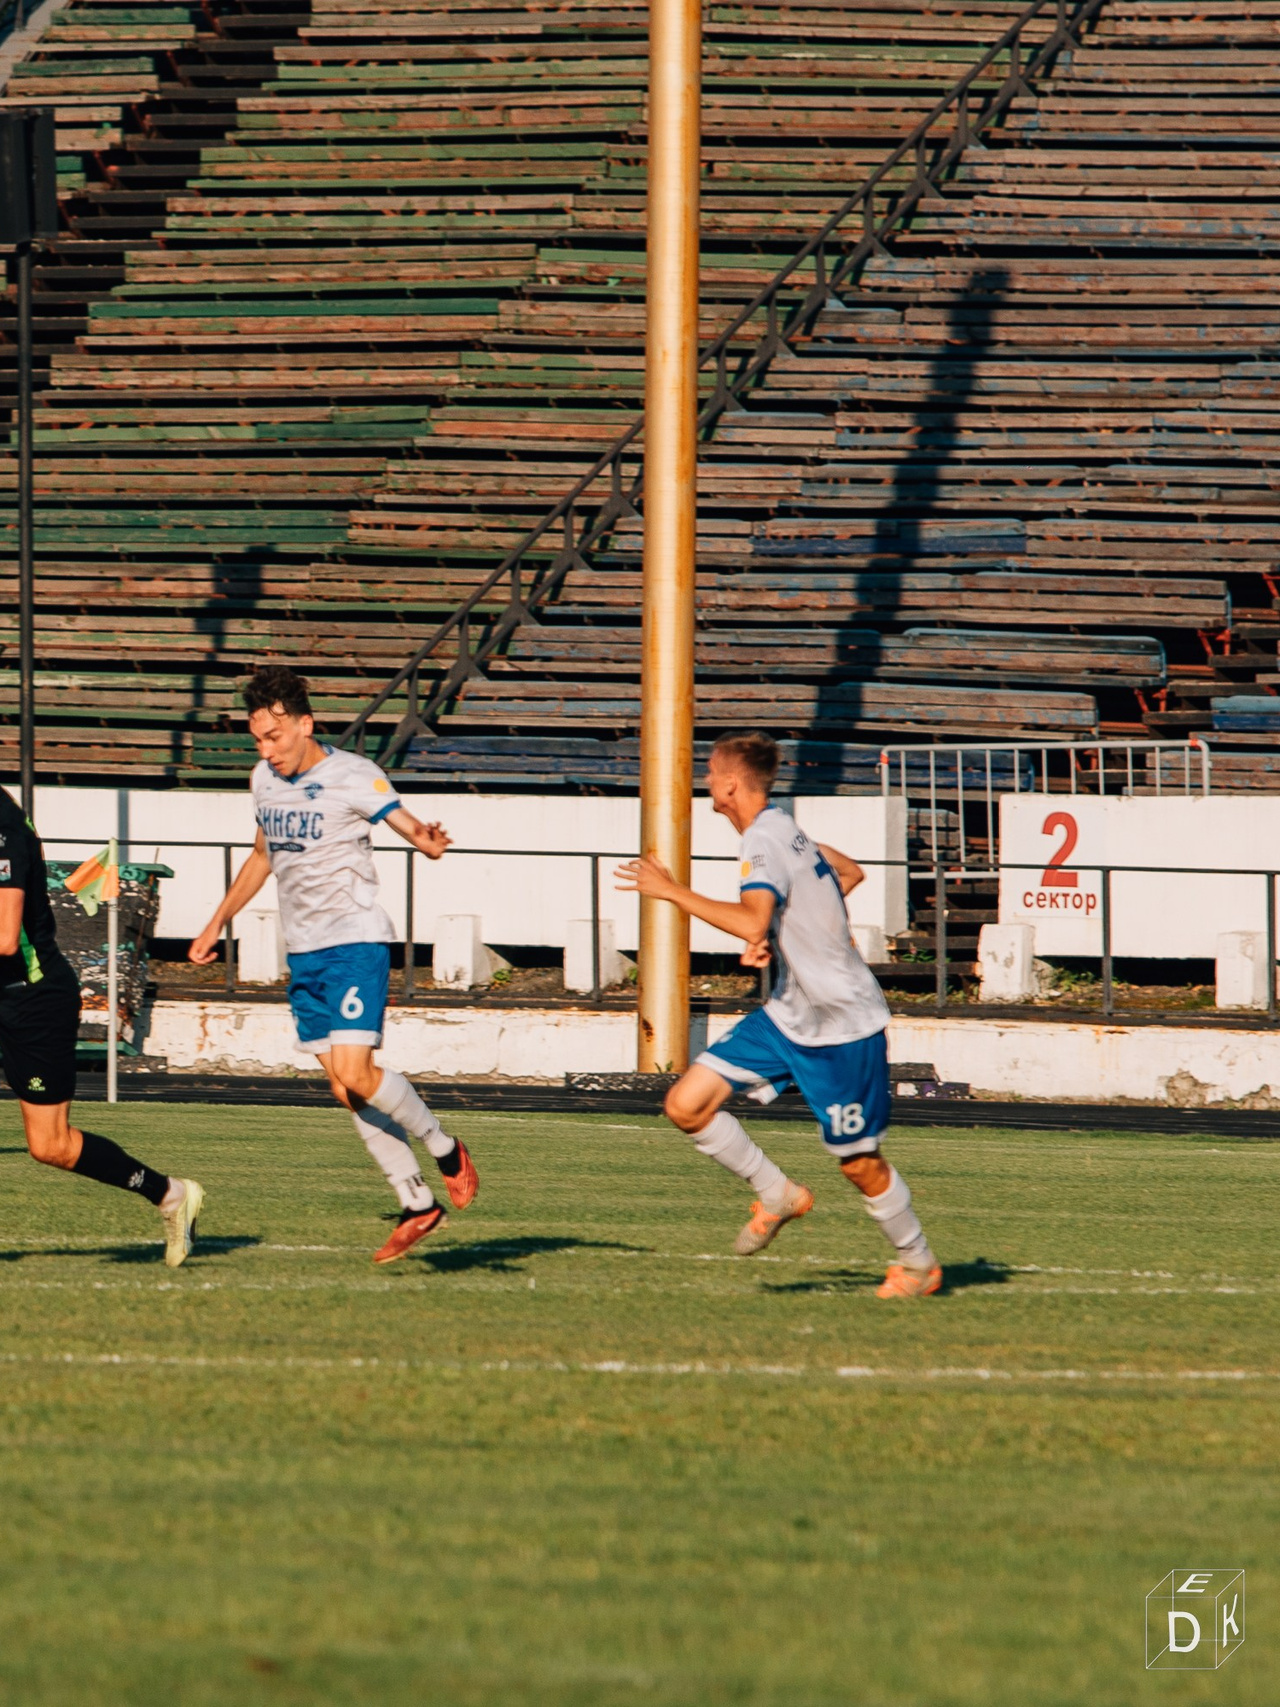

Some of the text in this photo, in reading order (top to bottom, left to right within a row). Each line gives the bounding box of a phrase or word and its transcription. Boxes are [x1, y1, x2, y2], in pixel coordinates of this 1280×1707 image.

[1040, 811, 1078, 887] 2
[1023, 891, 1097, 915] сектор
[340, 986, 364, 1020] 6
[825, 1103, 866, 1137] 18
